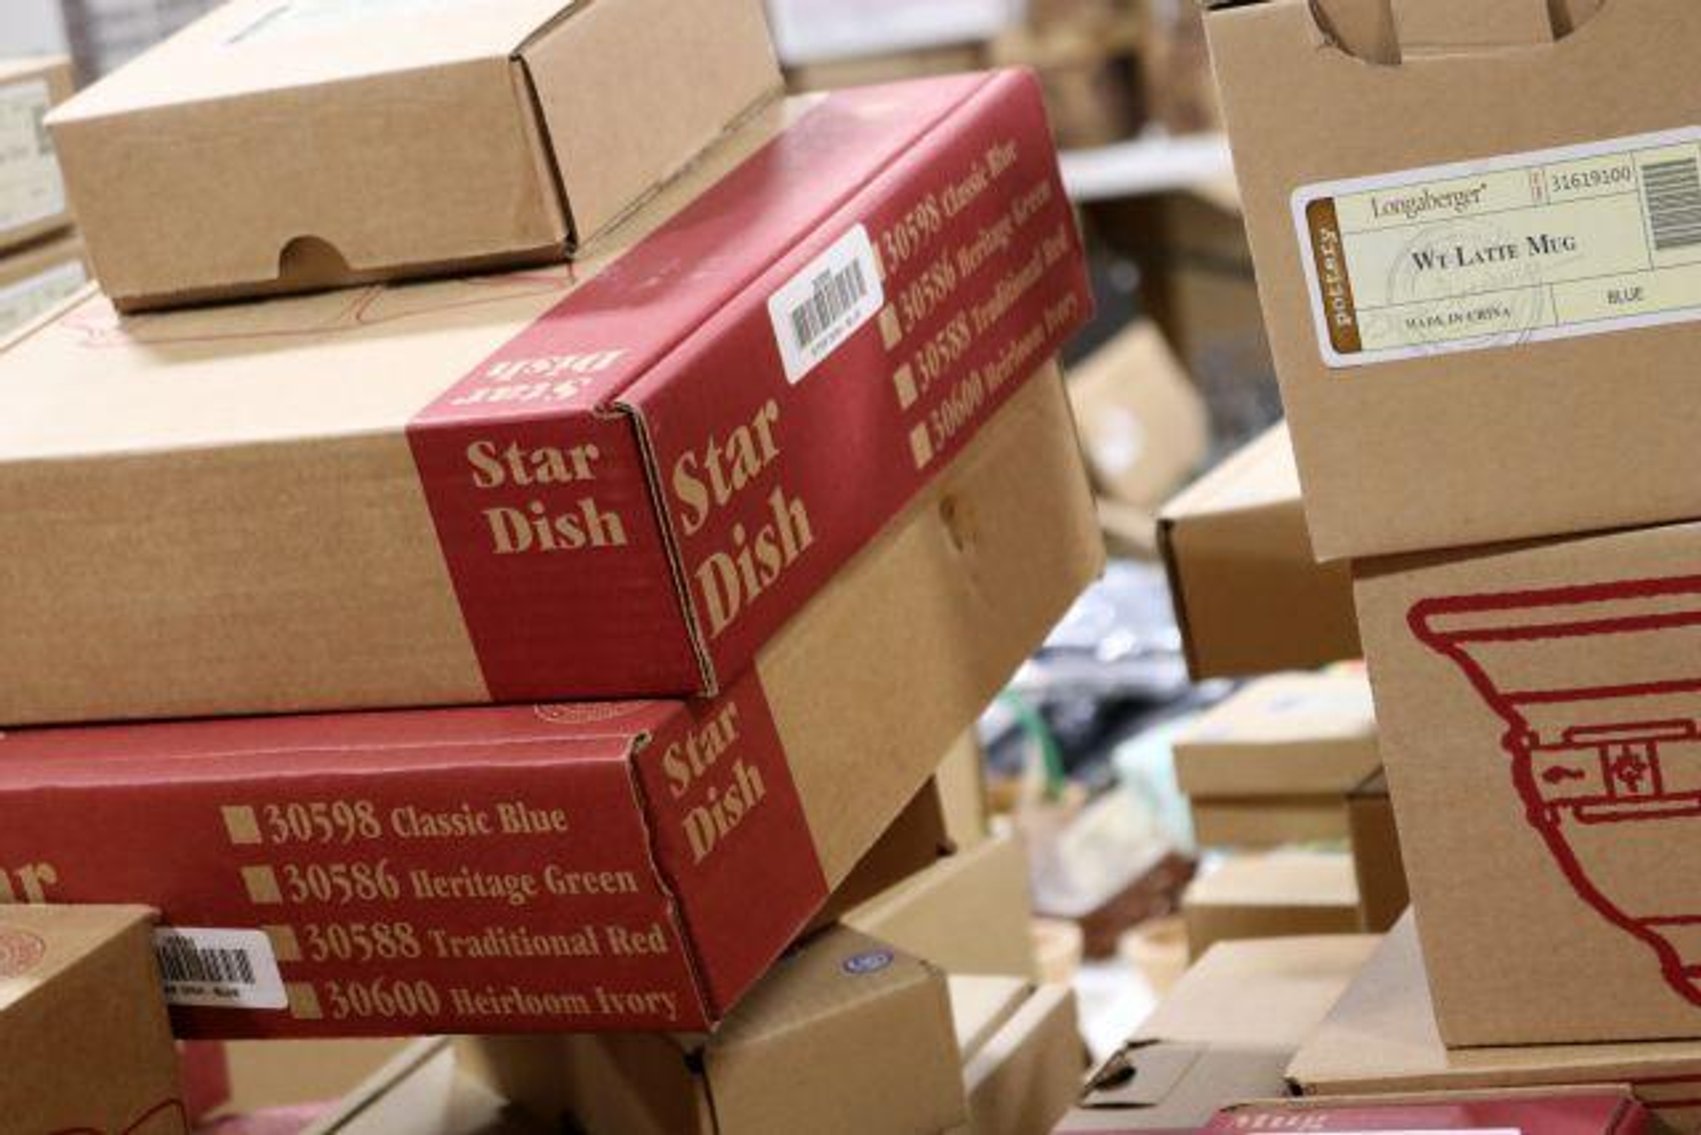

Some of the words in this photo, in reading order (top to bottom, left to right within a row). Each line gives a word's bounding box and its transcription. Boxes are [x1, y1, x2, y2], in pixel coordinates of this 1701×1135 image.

[1371, 183, 1486, 219] Longaberger
[1551, 166, 1632, 193] 31619100
[882, 193, 940, 273] 30598
[1456, 241, 1518, 268] LATTE
[1526, 233, 1577, 257] MUG
[900, 252, 956, 333] 30586
[1319, 227, 1351, 328] pottery
[1608, 286, 1644, 305] BLUE
[916, 309, 971, 392] 30588
[930, 369, 984, 449] 30600
[466, 441, 599, 488] Star
[671, 399, 780, 535] Star
[484, 497, 628, 553] Dish
[695, 486, 814, 638] Dish
[663, 702, 739, 798] Star
[264, 800, 382, 844] 30598
[391, 803, 490, 839] Classic
[500, 801, 568, 834] Blue
[682, 758, 766, 865] Dish
[283, 860, 399, 905] 30586
[410, 868, 537, 904] Heritage
[544, 864, 638, 896] Green
[304, 923, 421, 963] 30588
[428, 925, 599, 960] Traditional
[606, 923, 668, 955] Red
[324, 980, 440, 1020] 30600
[449, 988, 595, 1017] Heirloom
[595, 987, 677, 1020] Ivory
